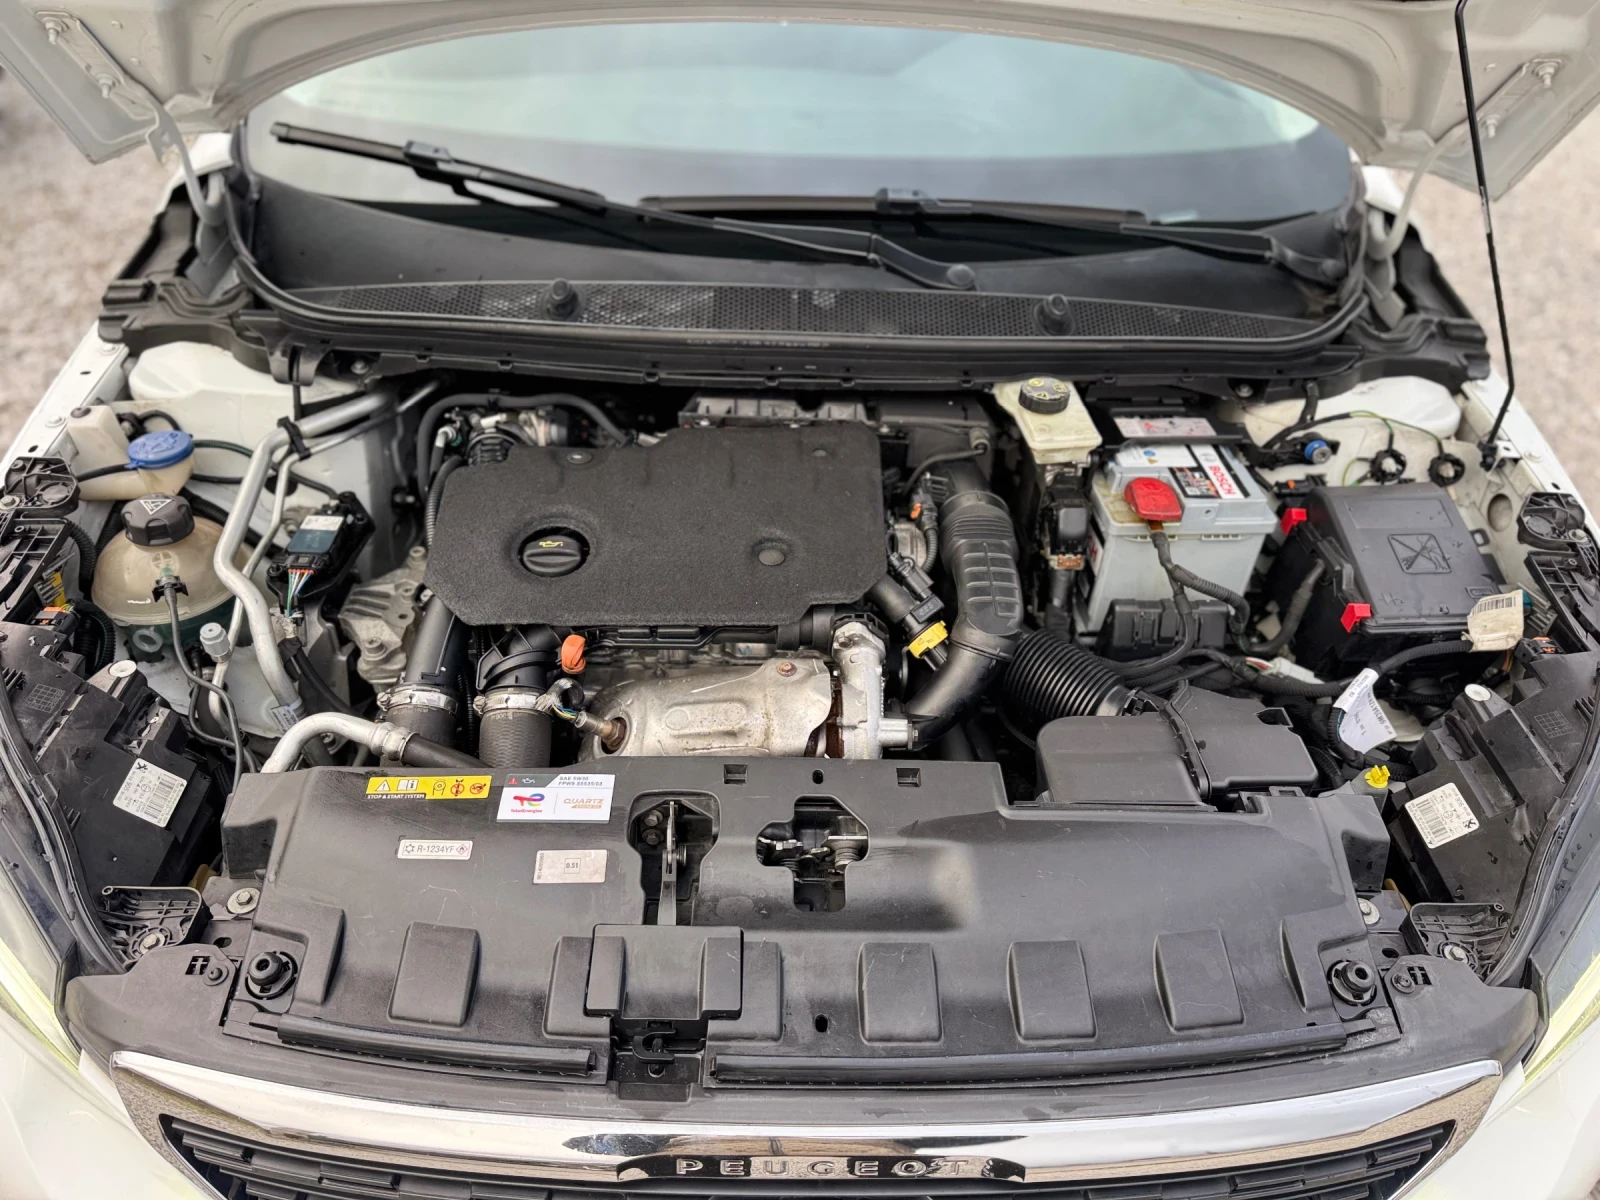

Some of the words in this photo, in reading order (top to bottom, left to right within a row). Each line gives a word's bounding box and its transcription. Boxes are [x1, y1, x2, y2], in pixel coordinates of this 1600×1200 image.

[1208, 465, 1237, 495] BOSCH
[416, 844, 455, 853] R-1234YF
[676, 1158, 969, 1176] PEUGEOT
